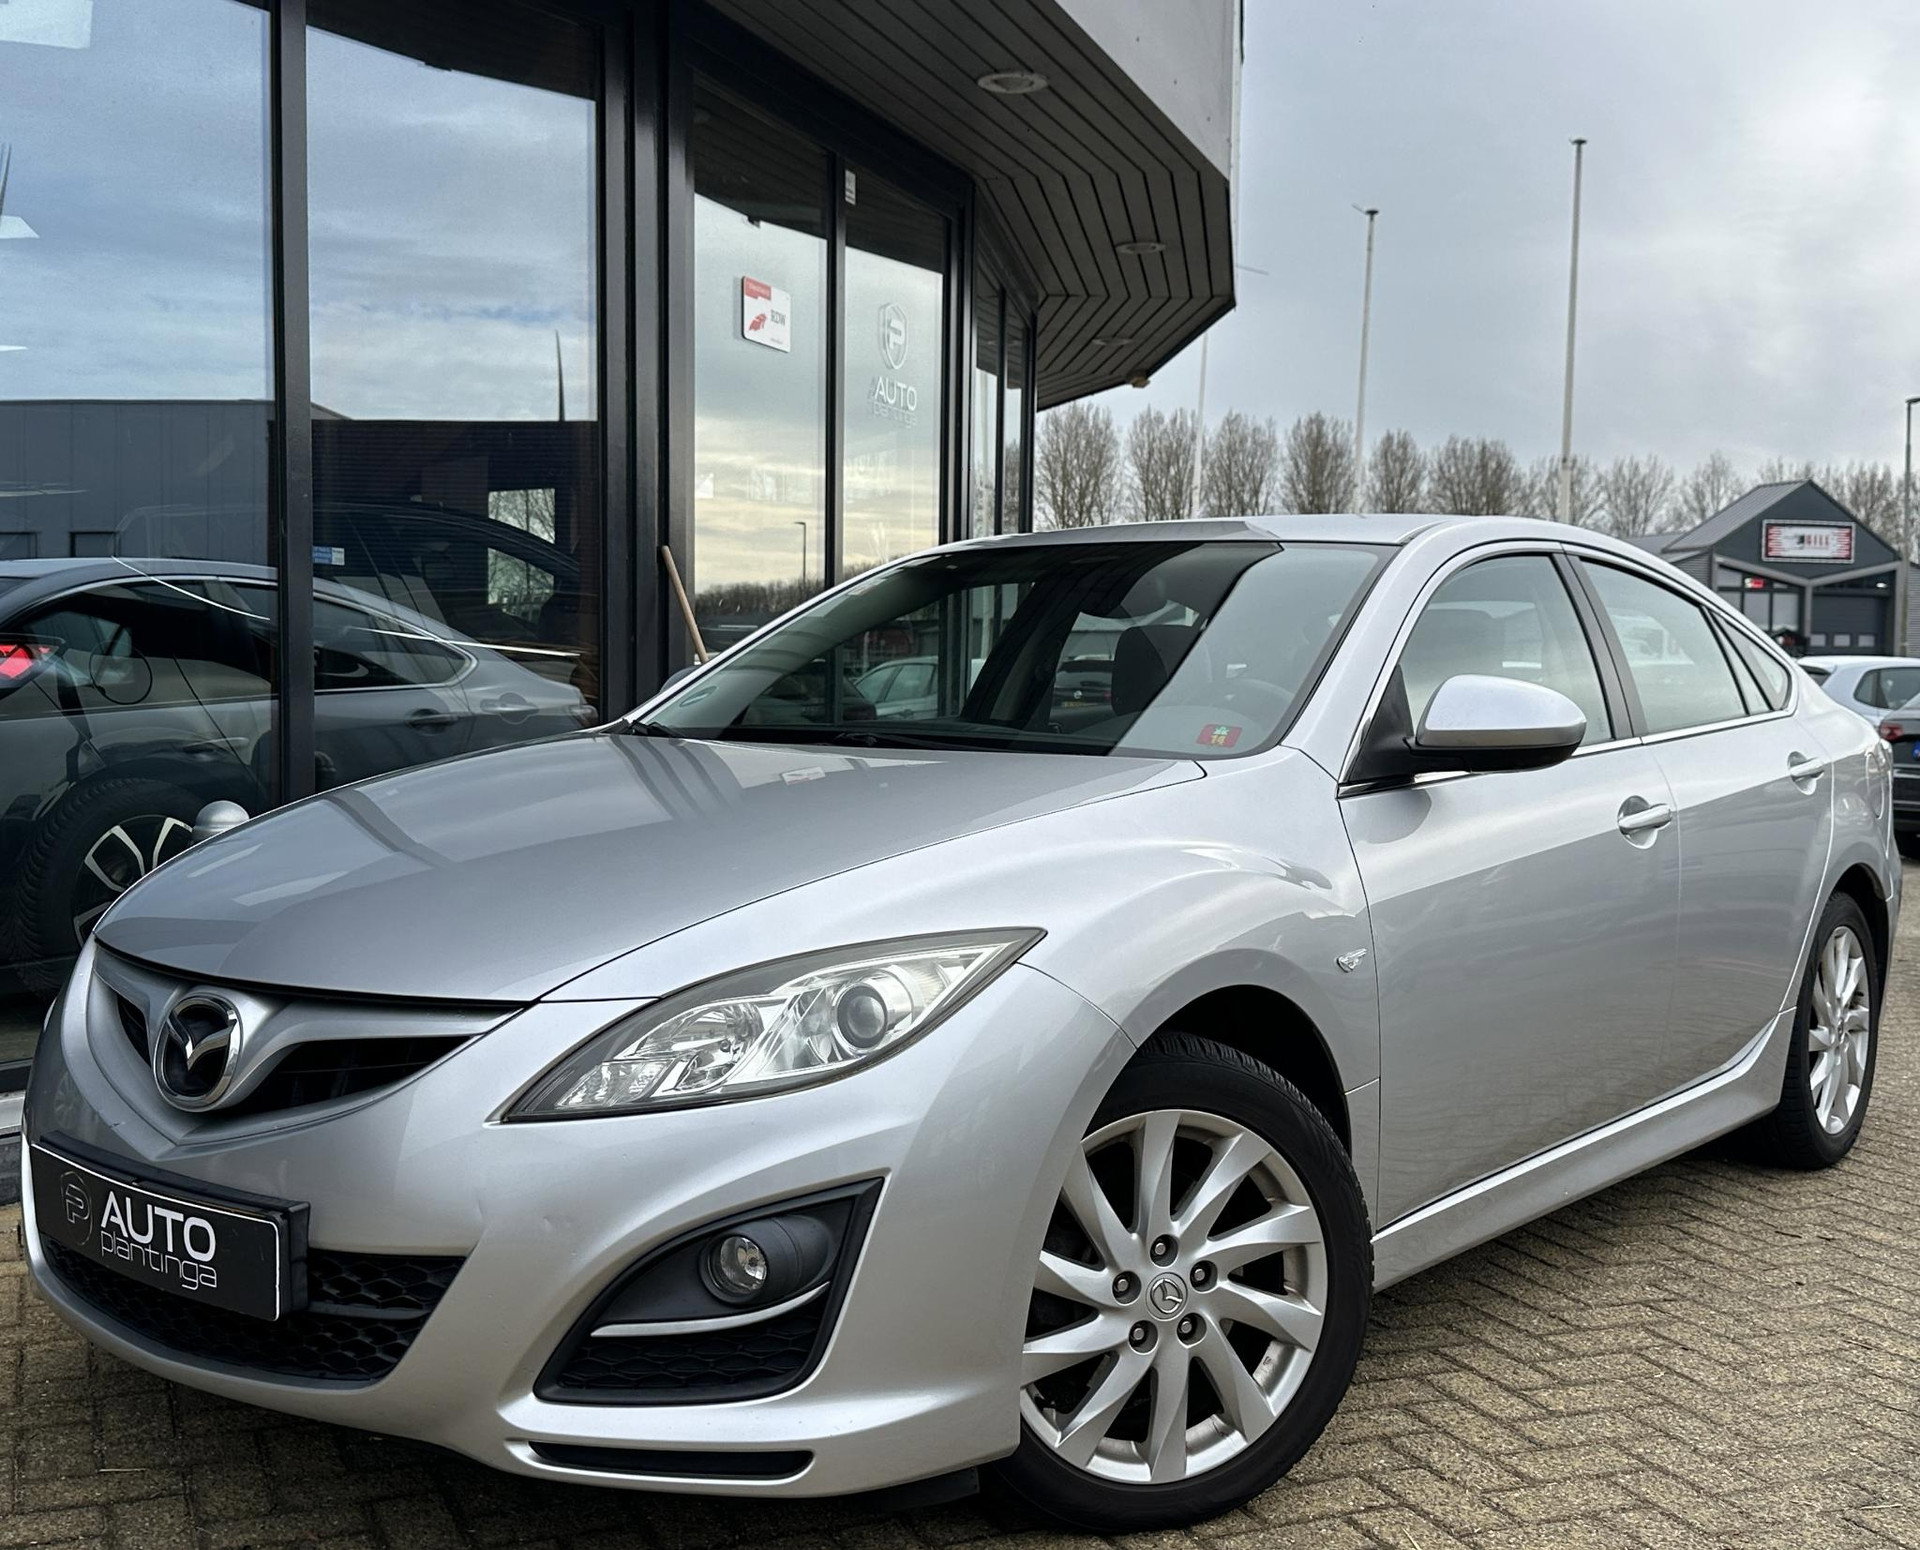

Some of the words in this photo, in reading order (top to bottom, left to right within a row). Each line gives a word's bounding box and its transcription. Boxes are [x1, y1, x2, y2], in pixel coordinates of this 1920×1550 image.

[874, 376, 917, 411] AUTO
[101, 1190, 216, 1262] AUTO
[101, 1231, 217, 1291] plantinga
